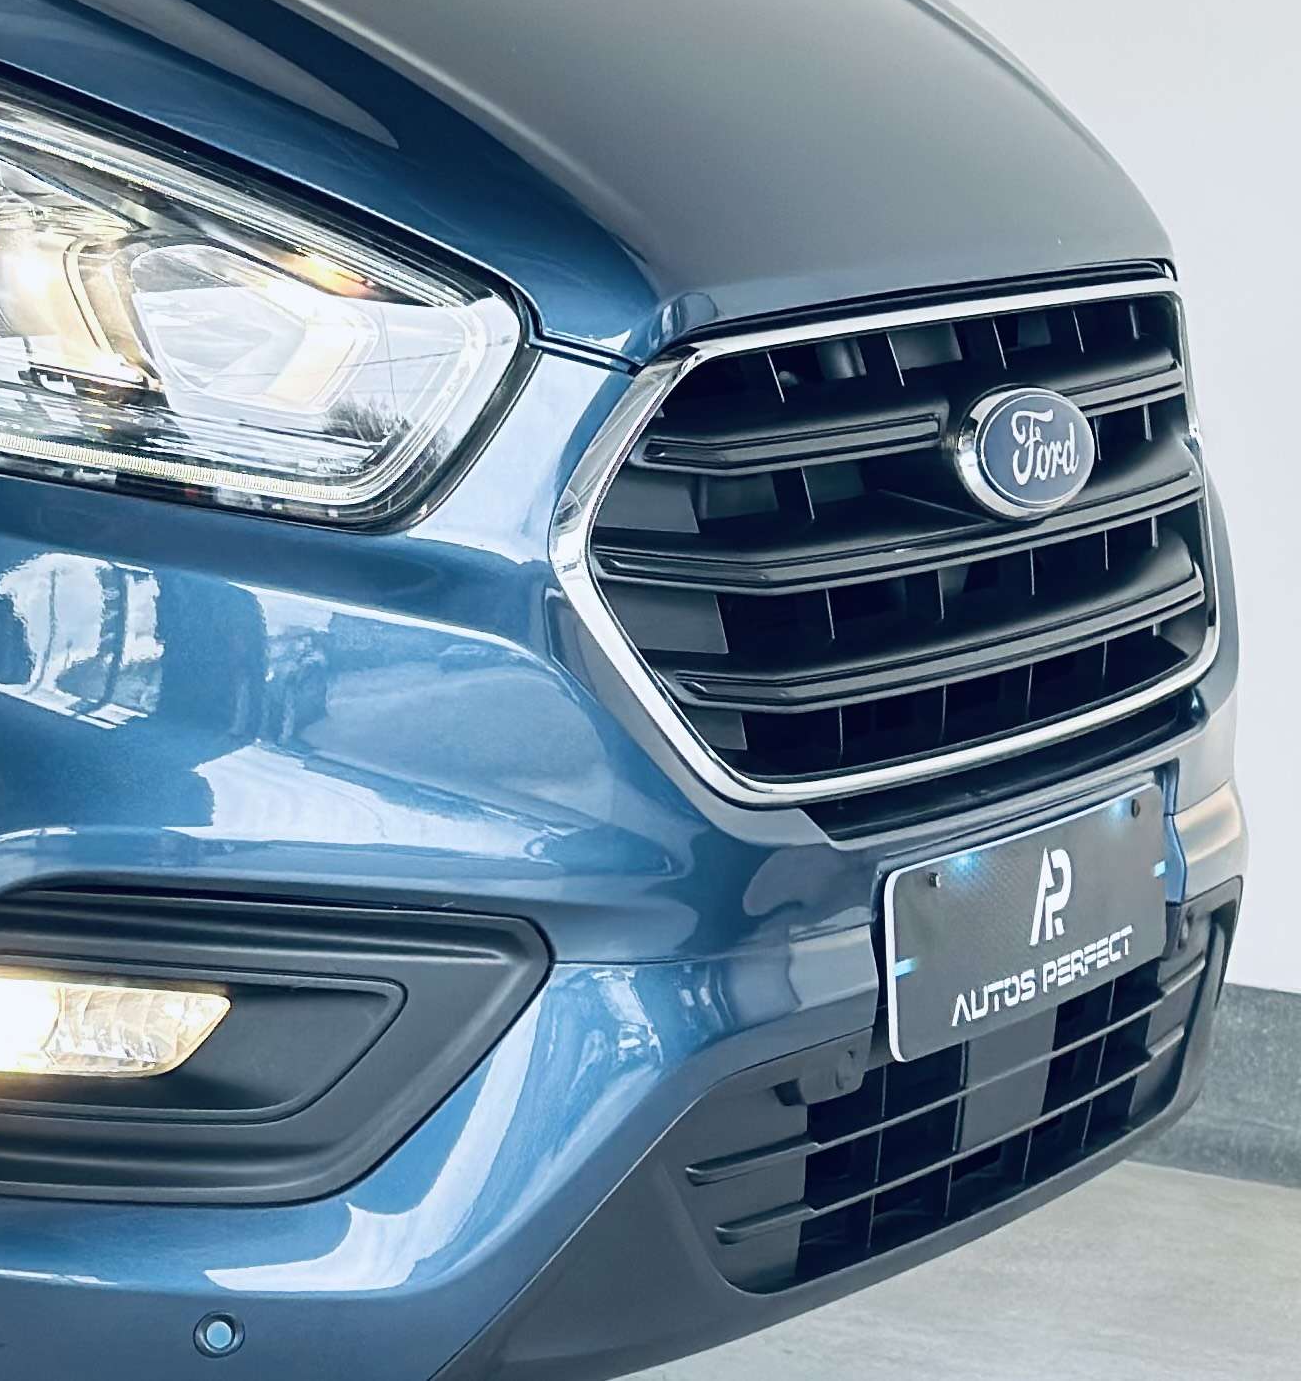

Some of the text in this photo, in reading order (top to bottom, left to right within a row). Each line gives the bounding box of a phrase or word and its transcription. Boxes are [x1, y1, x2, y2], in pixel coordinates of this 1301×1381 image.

[1011, 410, 1079, 486] Ford
[951, 925, 1133, 1027] AUTOS PERFECT
